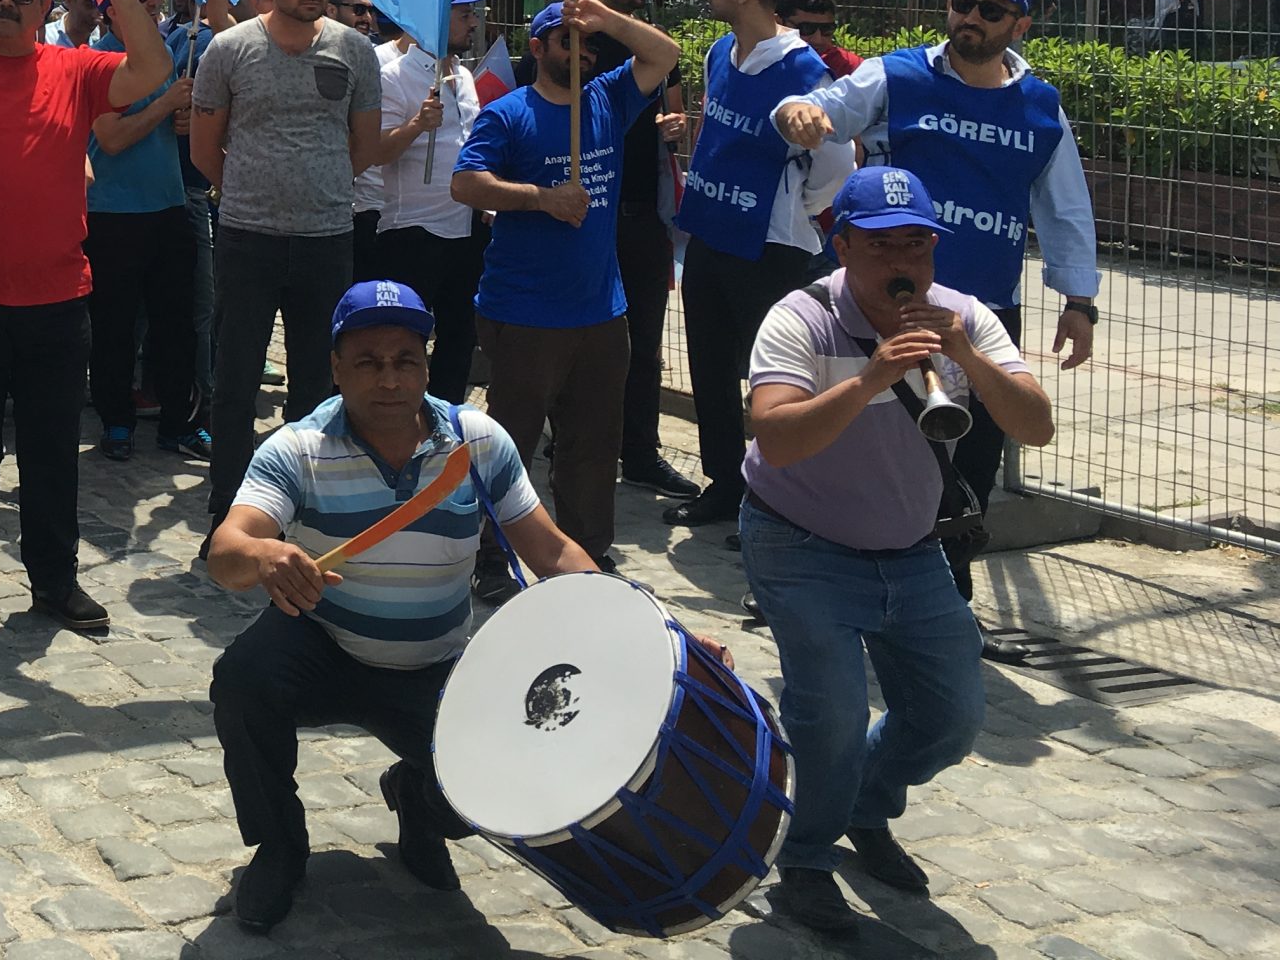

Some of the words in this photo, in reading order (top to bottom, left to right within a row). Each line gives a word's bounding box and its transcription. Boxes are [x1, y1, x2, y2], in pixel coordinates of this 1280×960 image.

[704, 97, 764, 137] ÖREVLİ
[918, 113, 1036, 153] GÖREVLİ
[686, 169, 758, 212] etrol-iş
[931, 200, 1024, 246] etrol-iş
